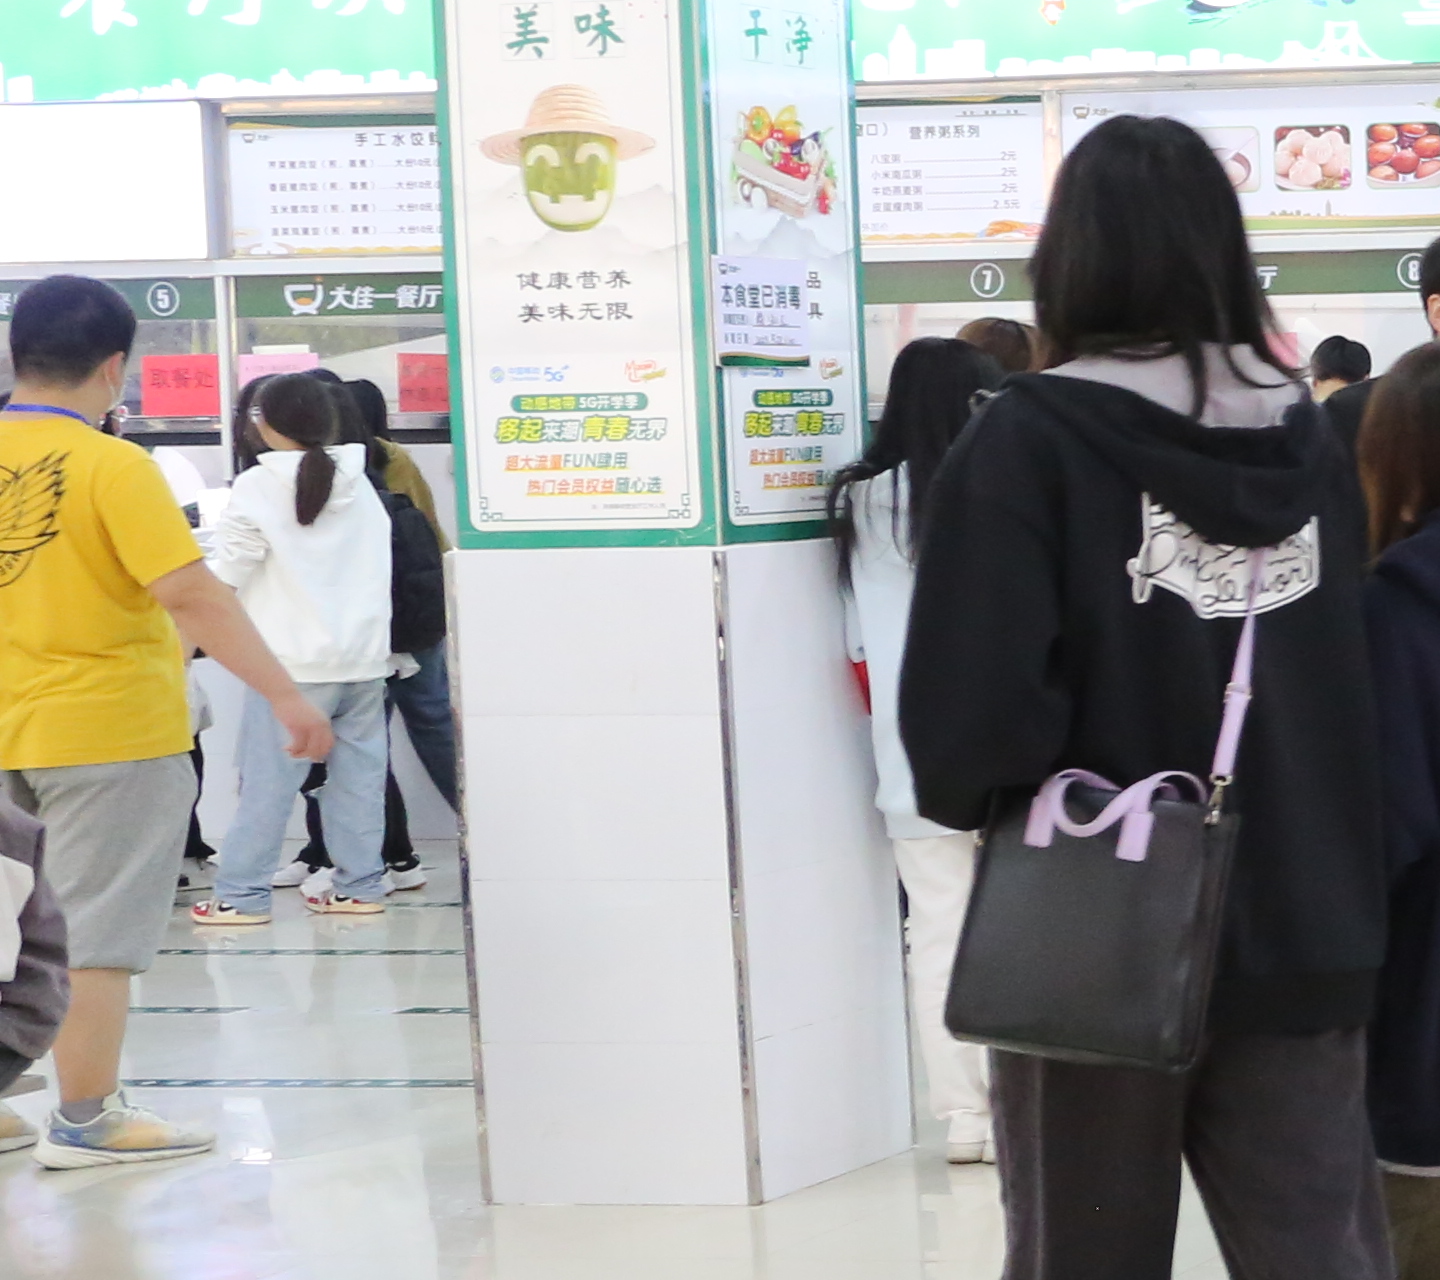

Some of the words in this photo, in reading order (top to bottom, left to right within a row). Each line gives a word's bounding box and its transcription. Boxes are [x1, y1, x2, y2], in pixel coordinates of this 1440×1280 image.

[506, 4, 625, 59] 美味
[744, 9, 812, 65] 干净
[909, 124, 980, 139] 营养粥系列
[1000, 151, 1017, 161] 2元
[1001, 167, 1018, 177] 2元
[1001, 183, 1018, 193] 2元
[516, 270, 632, 290] 健康营养
[327, 283, 442, 310] 大佳一餐厅
[720, 283, 800, 310] 本食堂已消毒
[518, 302, 633, 323] 美味无限
[150, 368, 215, 390] 取餐处
[495, 416, 581, 443] 移起来潮
[581, 414, 667, 441] 青春无界
